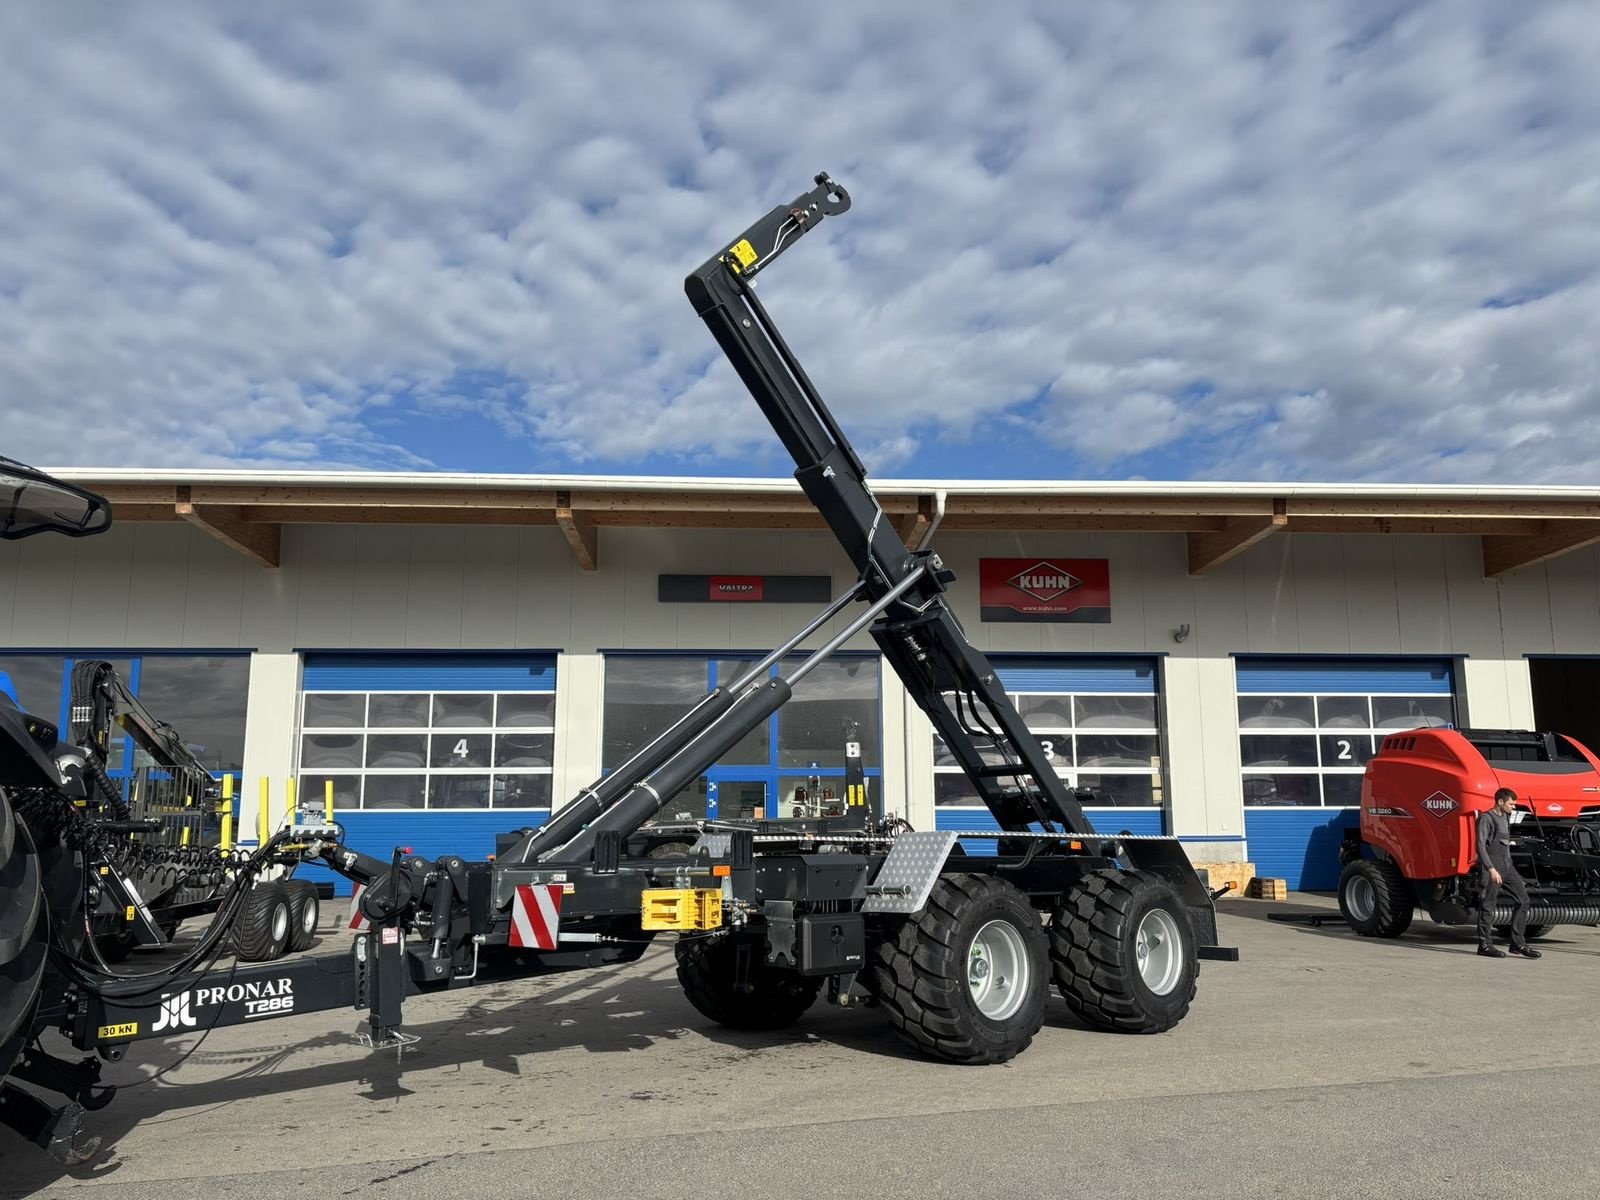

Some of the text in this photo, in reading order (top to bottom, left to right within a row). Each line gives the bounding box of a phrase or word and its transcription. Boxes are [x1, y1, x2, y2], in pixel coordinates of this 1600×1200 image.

[719, 584, 754, 592] VALTRA
[1020, 575, 1070, 589] KUHN
[453, 738, 469, 758] 4
[1040, 740, 1055, 761] 3
[1337, 740, 1352, 760] 2
[1426, 800, 1453, 809] KUHN
[195, 978, 294, 1007] PRONAR
[244, 995, 294, 1014] T286
[103, 1024, 133, 1036] 30 kN
